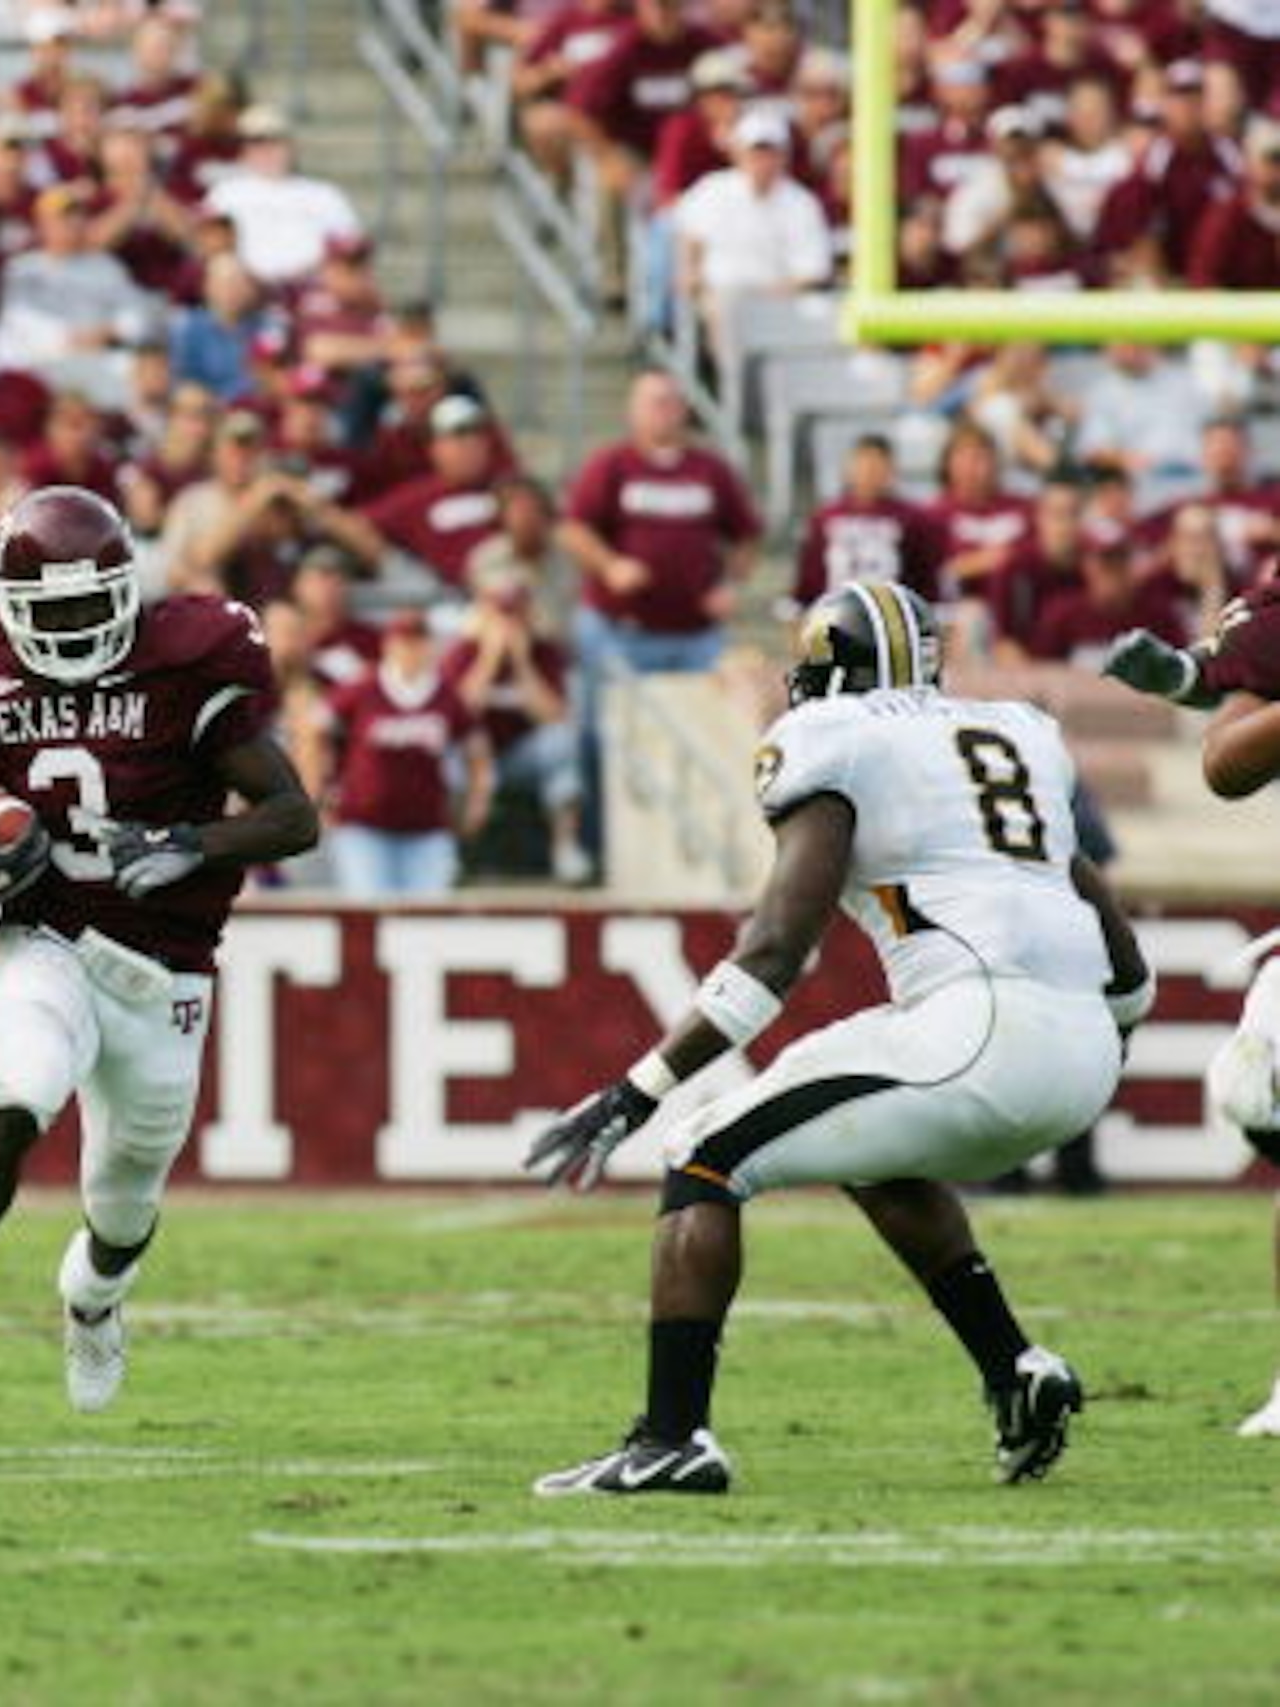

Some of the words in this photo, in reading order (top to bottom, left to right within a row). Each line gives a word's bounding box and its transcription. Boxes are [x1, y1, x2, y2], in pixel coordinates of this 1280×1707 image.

[86, 691, 147, 739] A&M
[27, 747, 115, 882] 3
[955, 729, 1048, 862] 8
